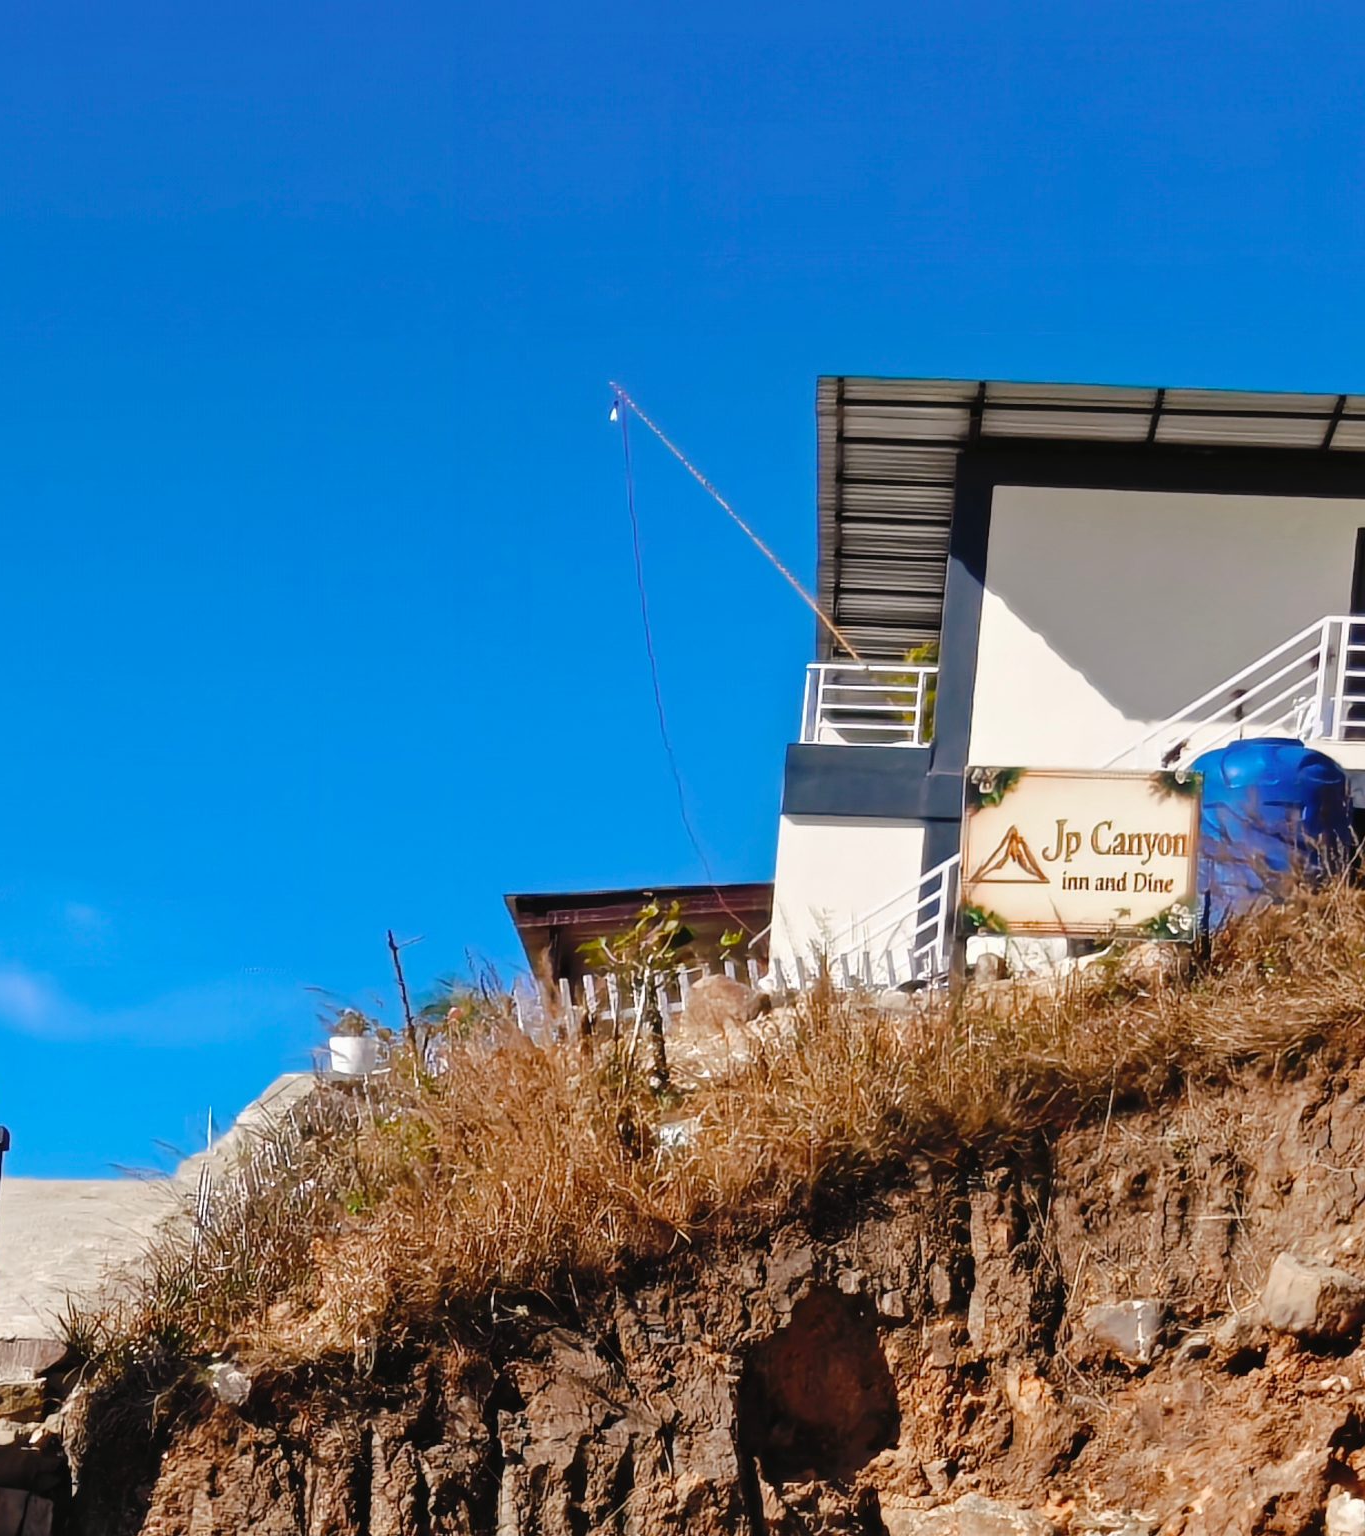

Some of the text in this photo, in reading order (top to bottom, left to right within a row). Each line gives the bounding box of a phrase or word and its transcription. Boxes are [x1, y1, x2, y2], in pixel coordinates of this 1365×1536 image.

[1042, 819, 1189, 865] Jp Canyon
[1062, 871, 1174, 893] inn and Dine
